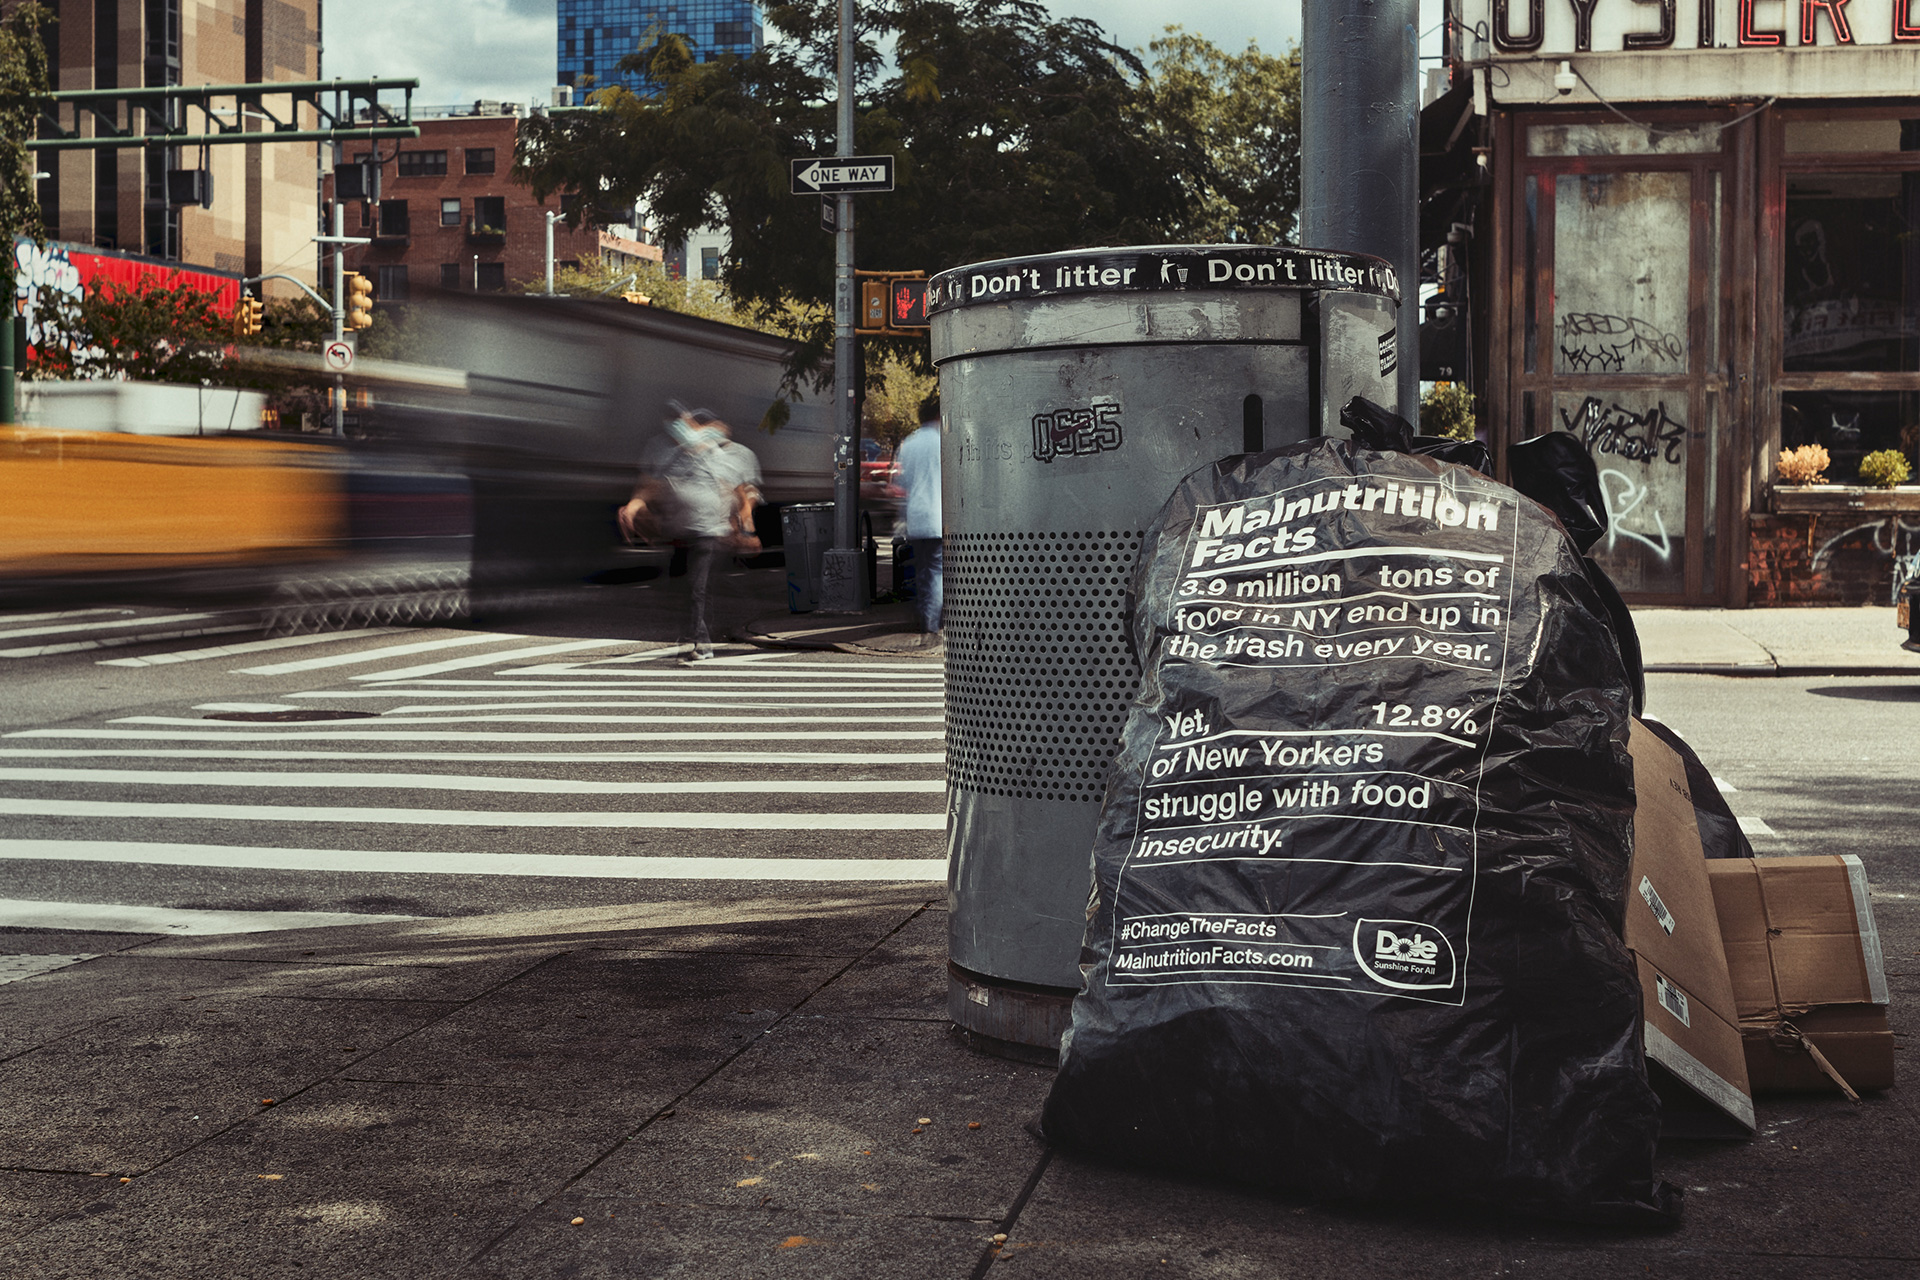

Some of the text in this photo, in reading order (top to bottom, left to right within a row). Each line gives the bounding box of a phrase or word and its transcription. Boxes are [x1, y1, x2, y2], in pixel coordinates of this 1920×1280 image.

[811, 167, 879, 182] ONE WAY
[972, 264, 1137, 298] Don't litter
[1208, 258, 1297, 282] Don't
[1310, 258, 1364, 285] litter
[1200, 481, 1499, 538] Malnutrition
[1190, 525, 1317, 568] Facts
[1178, 565, 1501, 598] 3.9 million tons of
[1174, 600, 1501, 632] food in NY end up in
[1168, 633, 1492, 662] the trash every year.
[1164, 701, 1478, 740] Yet, 12.8%
[1151, 739, 1384, 779] of New Yorkers
[1144, 779, 1432, 822] struggle with food
[1136, 823, 1283, 858] insecurity.
[1120, 916, 1277, 941] #ChangeTheFacts
[1375, 929, 1439, 960] Dole
[1115, 946, 1314, 970] MalnutritionFacts.com
[1373, 960, 1436, 975] Sunshine For All
